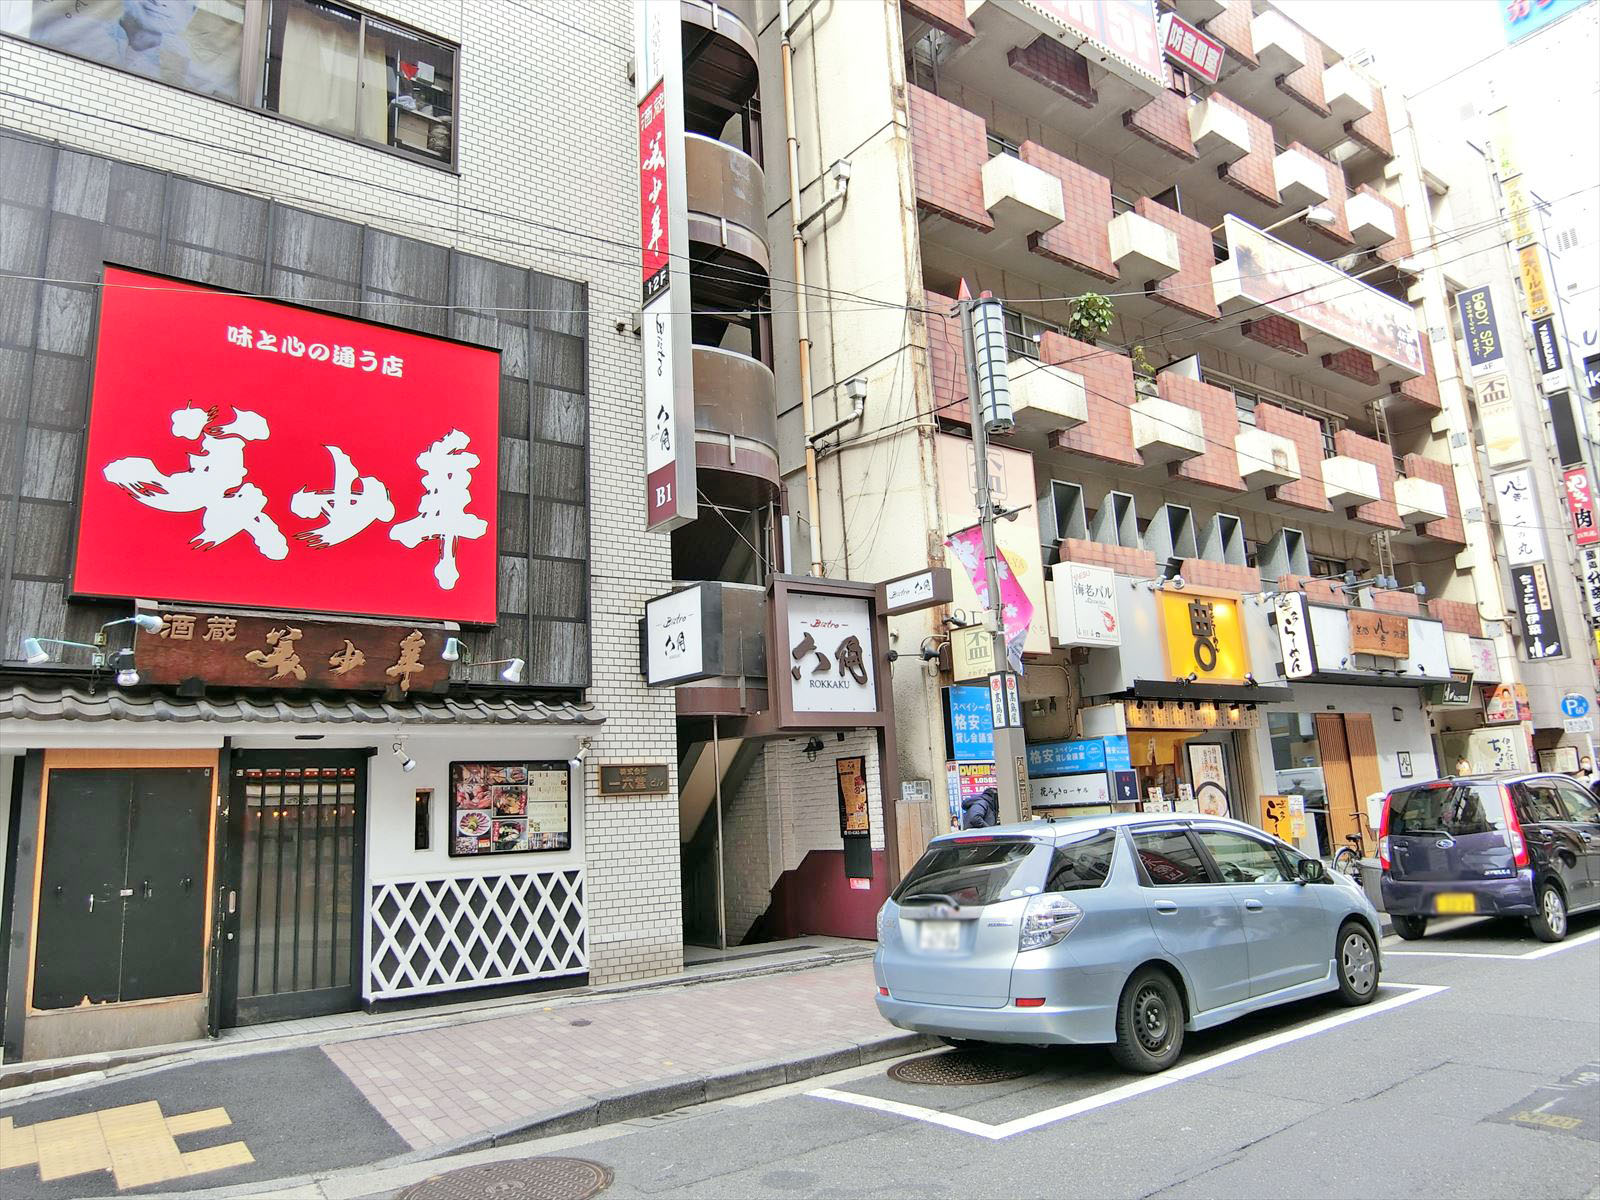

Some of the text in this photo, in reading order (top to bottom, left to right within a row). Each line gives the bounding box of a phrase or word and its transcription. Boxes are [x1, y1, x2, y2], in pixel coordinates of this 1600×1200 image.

[641, 93, 666, 132] 酒蔵
[1472, 292, 1489, 326] BODY
[227, 325, 405, 379] 味と心の通う店
[103, 399, 488, 592] 美少年
[655, 483, 673, 508] B1
[1074, 582, 1113, 599] 海老バル
[161, 613, 238, 642] 酒蔵
[810, 618, 840, 629] Bistro
[243, 625, 428, 692] 美少年
[809, 679, 850, 689] ROKKAKU
[954, 713, 981, 730] 格安
[1030, 749, 1054, 764] 格安
